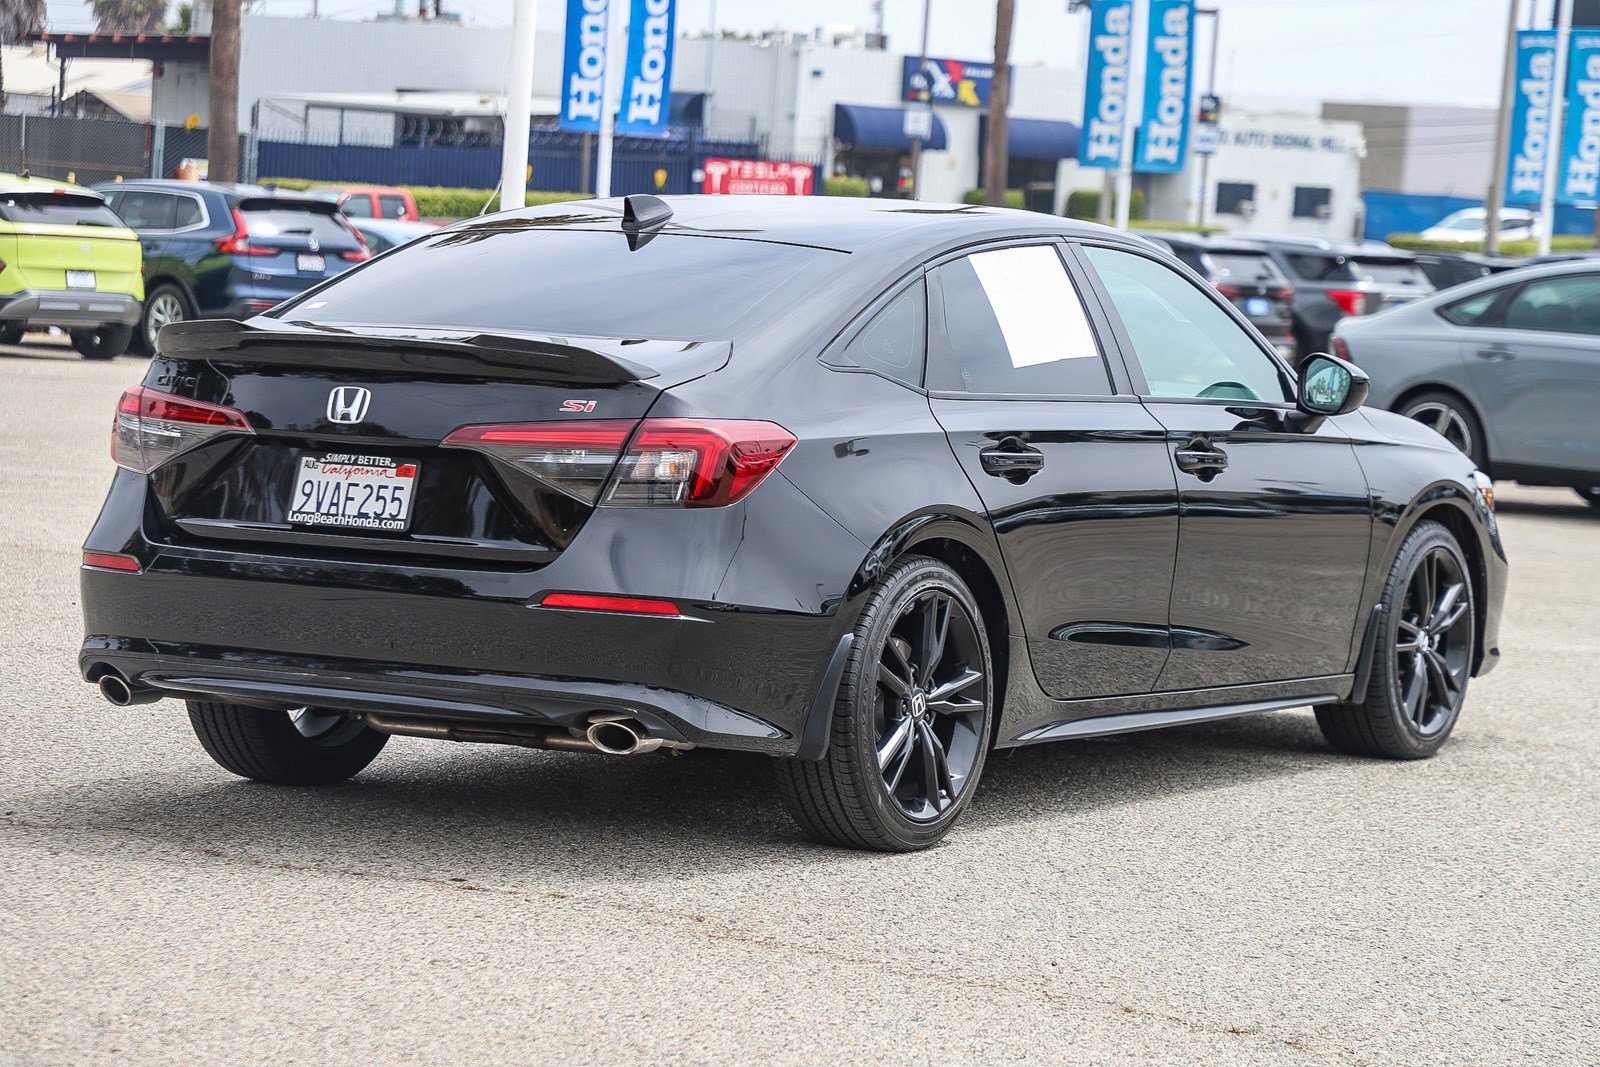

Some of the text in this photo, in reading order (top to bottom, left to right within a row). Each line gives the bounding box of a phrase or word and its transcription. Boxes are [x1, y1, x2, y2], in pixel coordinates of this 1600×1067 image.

[1086, 3, 1130, 161] Honda
[1144, 4, 1189, 164] Honda
[1511, 51, 1554, 194] Honda
[730, 160, 793, 180] TESLA
[321, 463, 395, 480] California
[325, 453, 392, 466] SIMPLY BETTER
[297, 479, 405, 518] 9VAF255
[287, 511, 405, 529] LongBeachHonda.com
